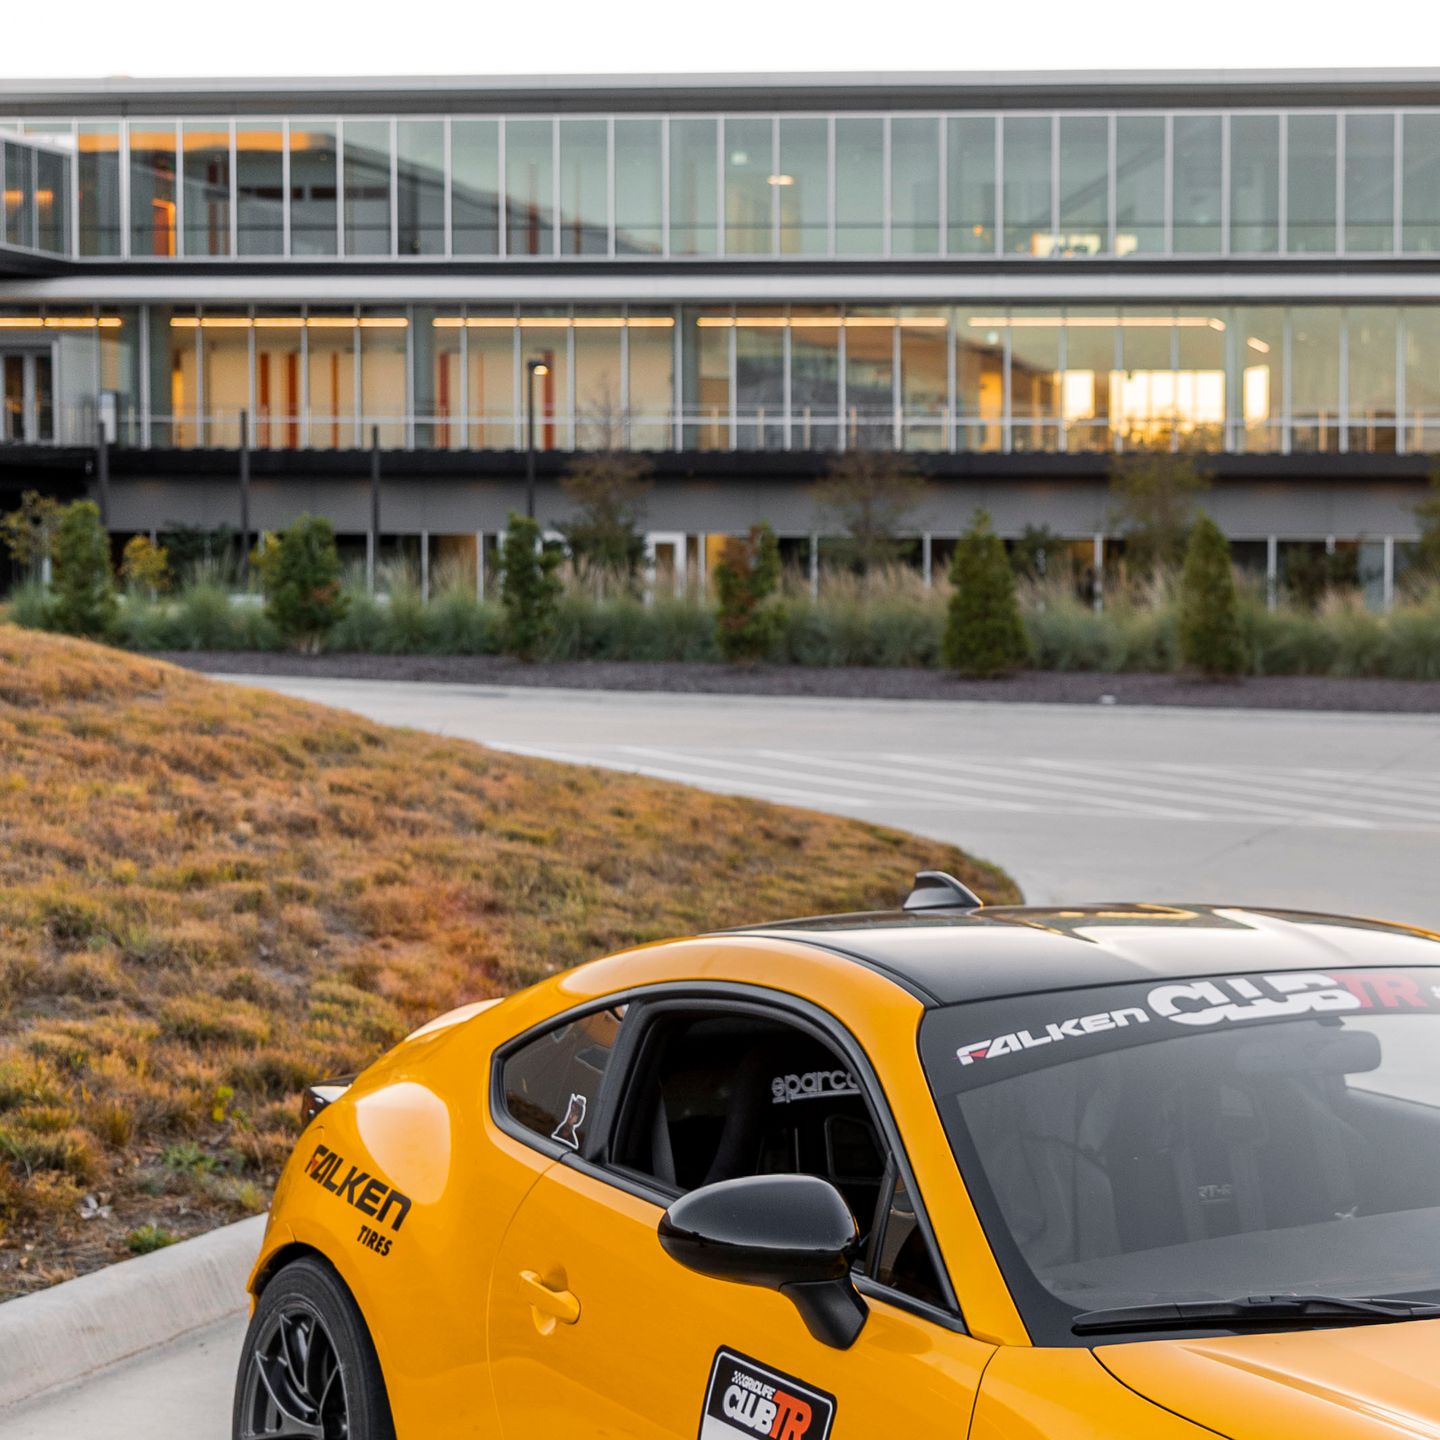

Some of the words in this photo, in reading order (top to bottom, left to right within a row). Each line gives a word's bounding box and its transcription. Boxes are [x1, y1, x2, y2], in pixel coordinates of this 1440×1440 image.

[956, 1007, 1150, 1066] FALKEN
[304, 1144, 412, 1231] FALKEN
[356, 1225, 393, 1257] TIRES
